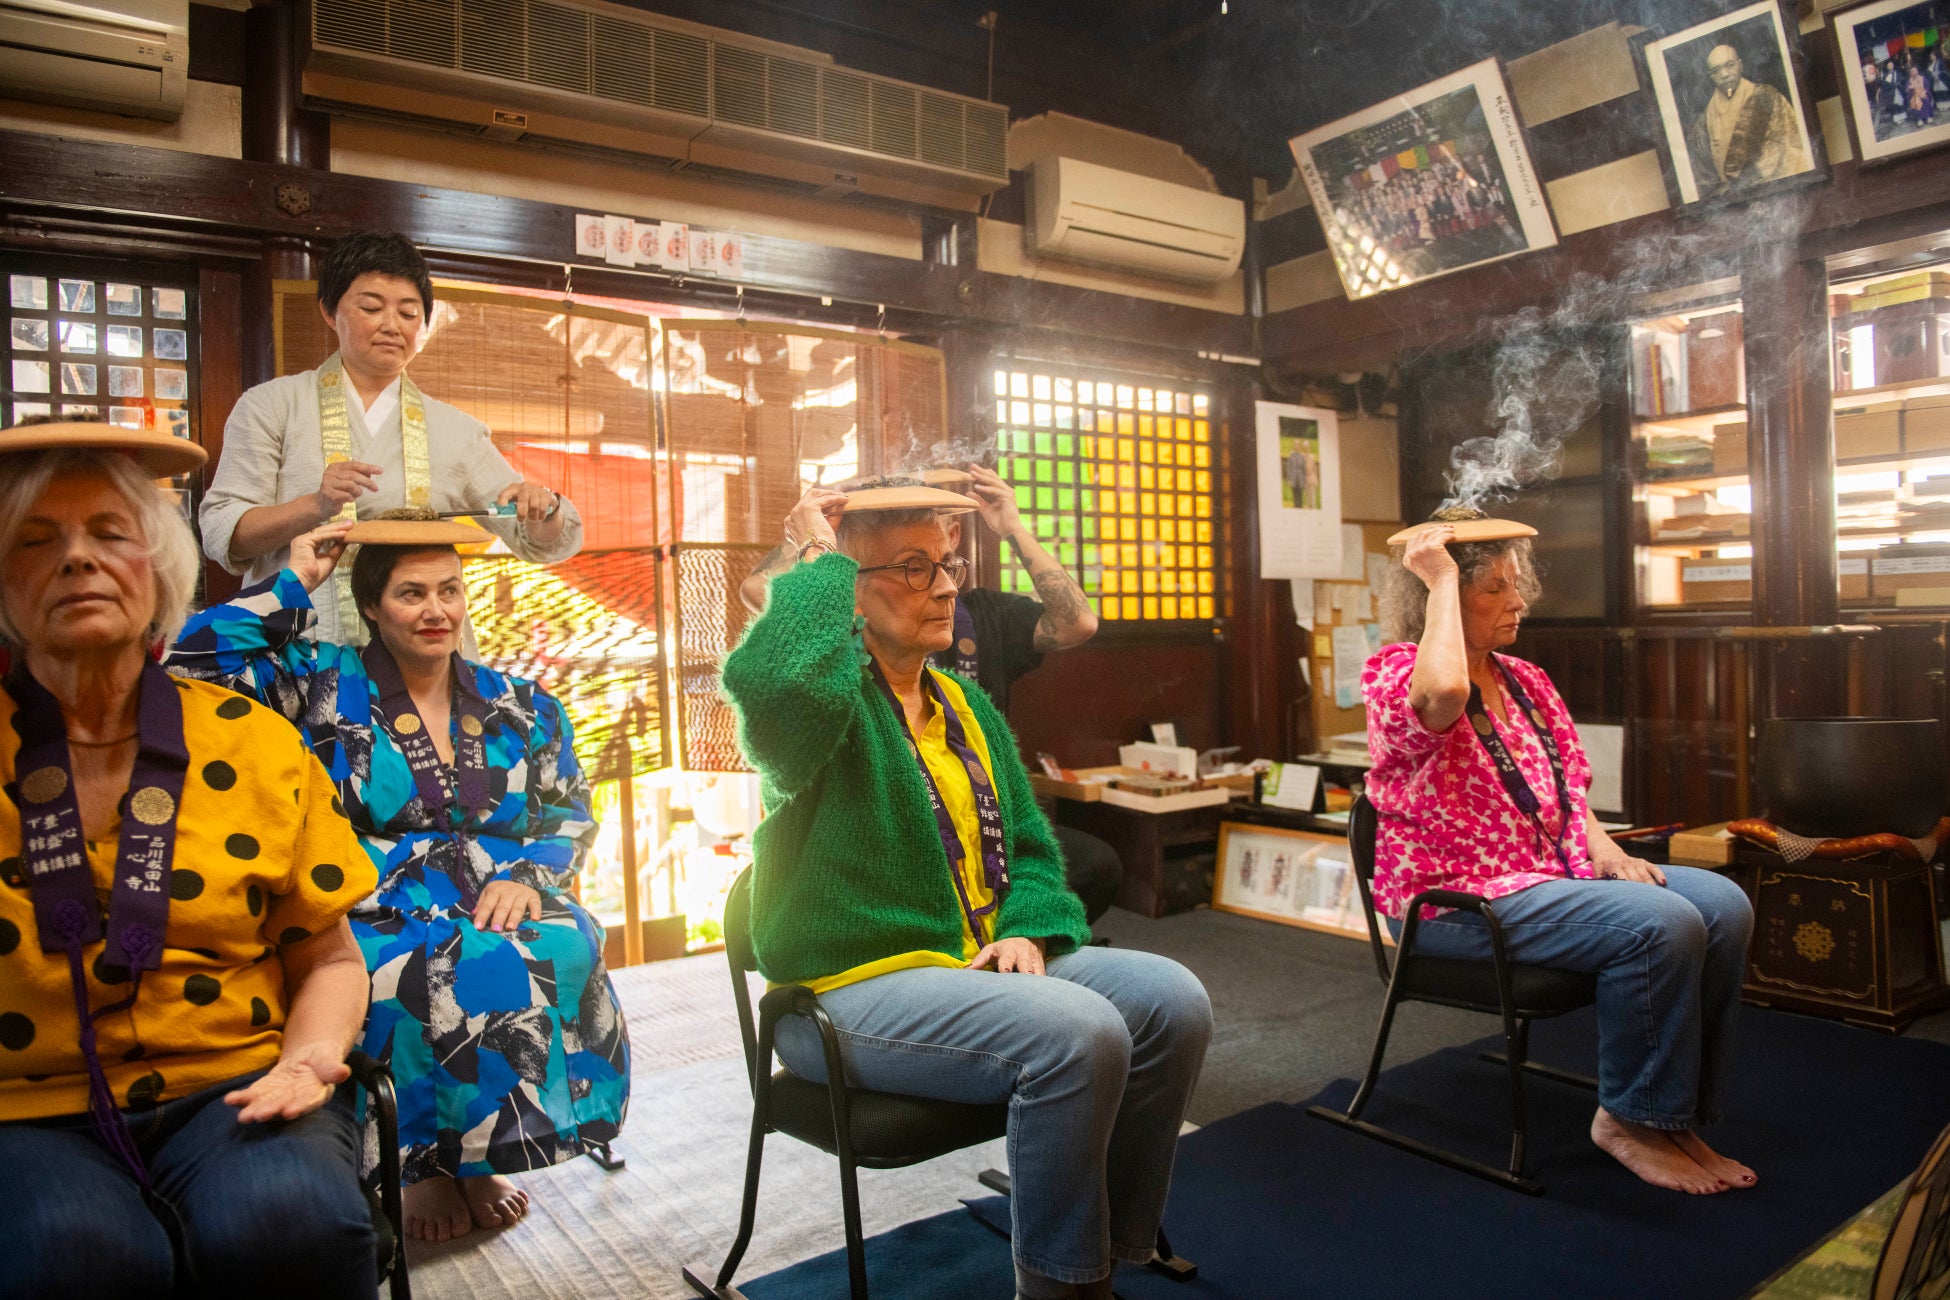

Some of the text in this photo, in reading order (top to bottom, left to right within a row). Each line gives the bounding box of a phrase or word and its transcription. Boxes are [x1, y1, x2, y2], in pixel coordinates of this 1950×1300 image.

[124, 834, 149, 891] 一心寺
[143, 836, 166, 893] 品川成田山
